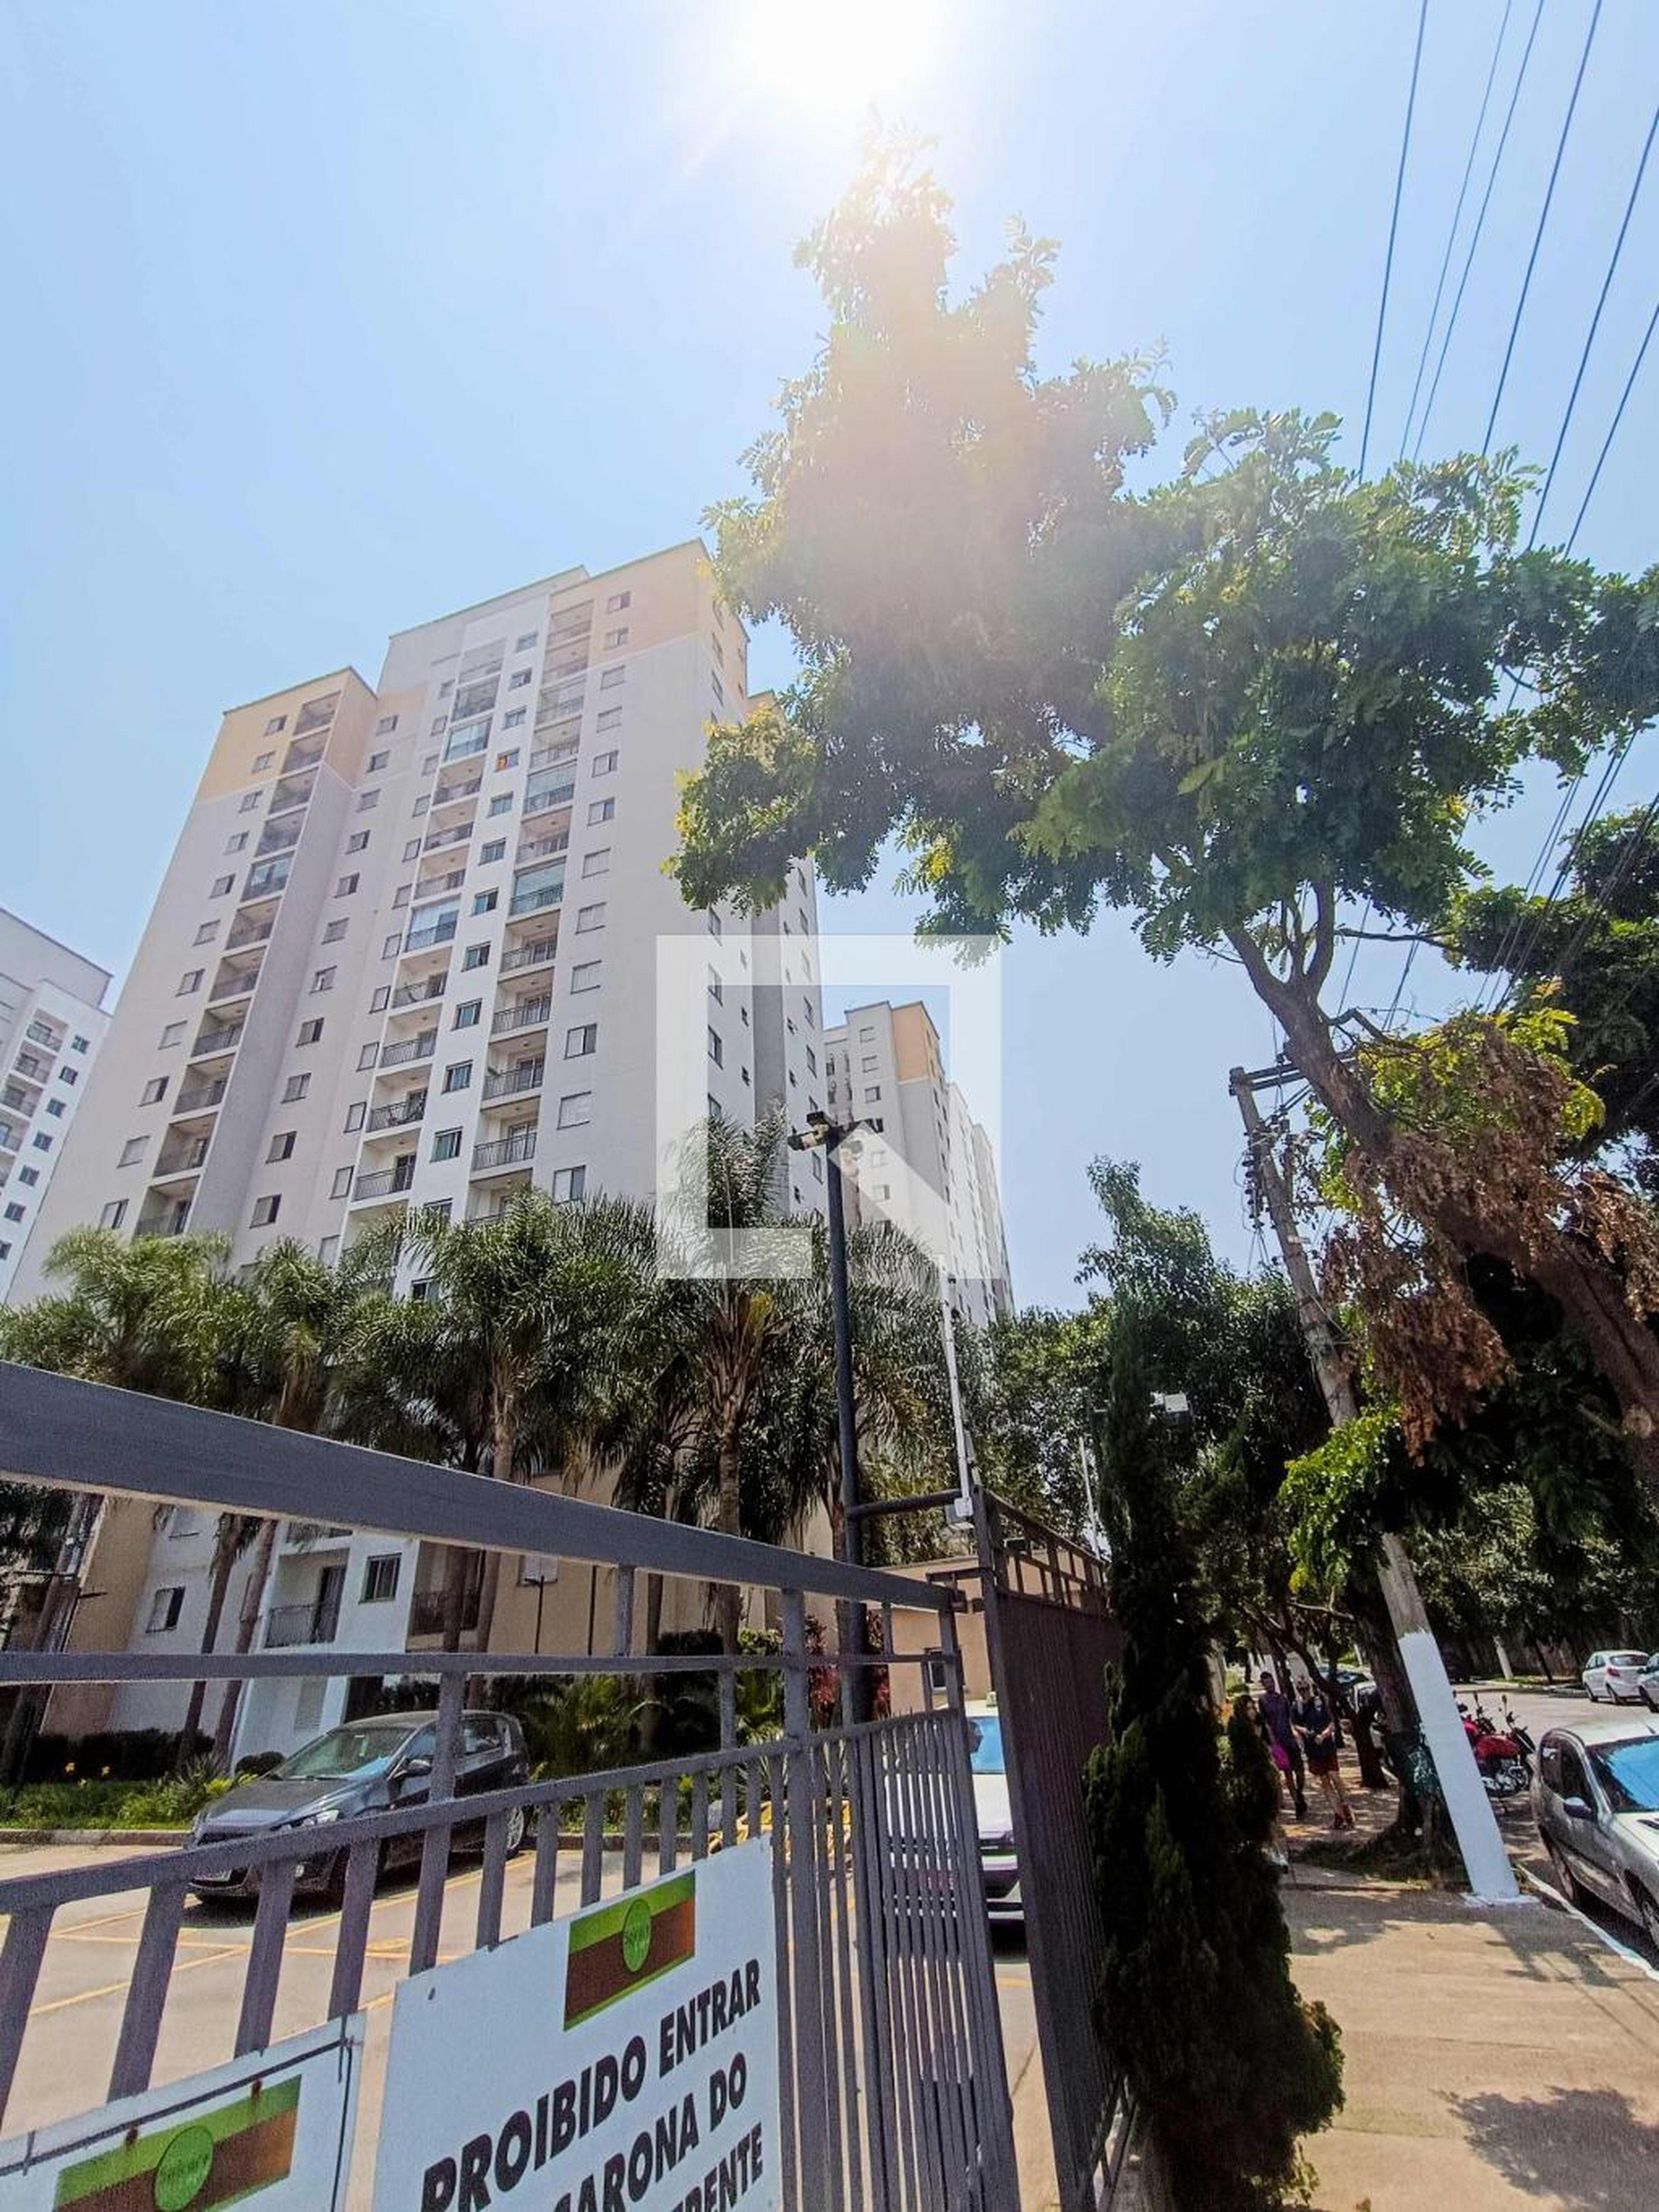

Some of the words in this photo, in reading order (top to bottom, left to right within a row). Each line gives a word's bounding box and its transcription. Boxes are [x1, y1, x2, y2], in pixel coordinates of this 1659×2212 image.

[421, 2036, 646, 2212] PROIBIDO
[659, 1959, 760, 2078] ENTRAR
[553, 2092, 699, 2212] ARONA
[710, 2053, 747, 2132] DO
[671, 2122, 763, 2212] ENTE
